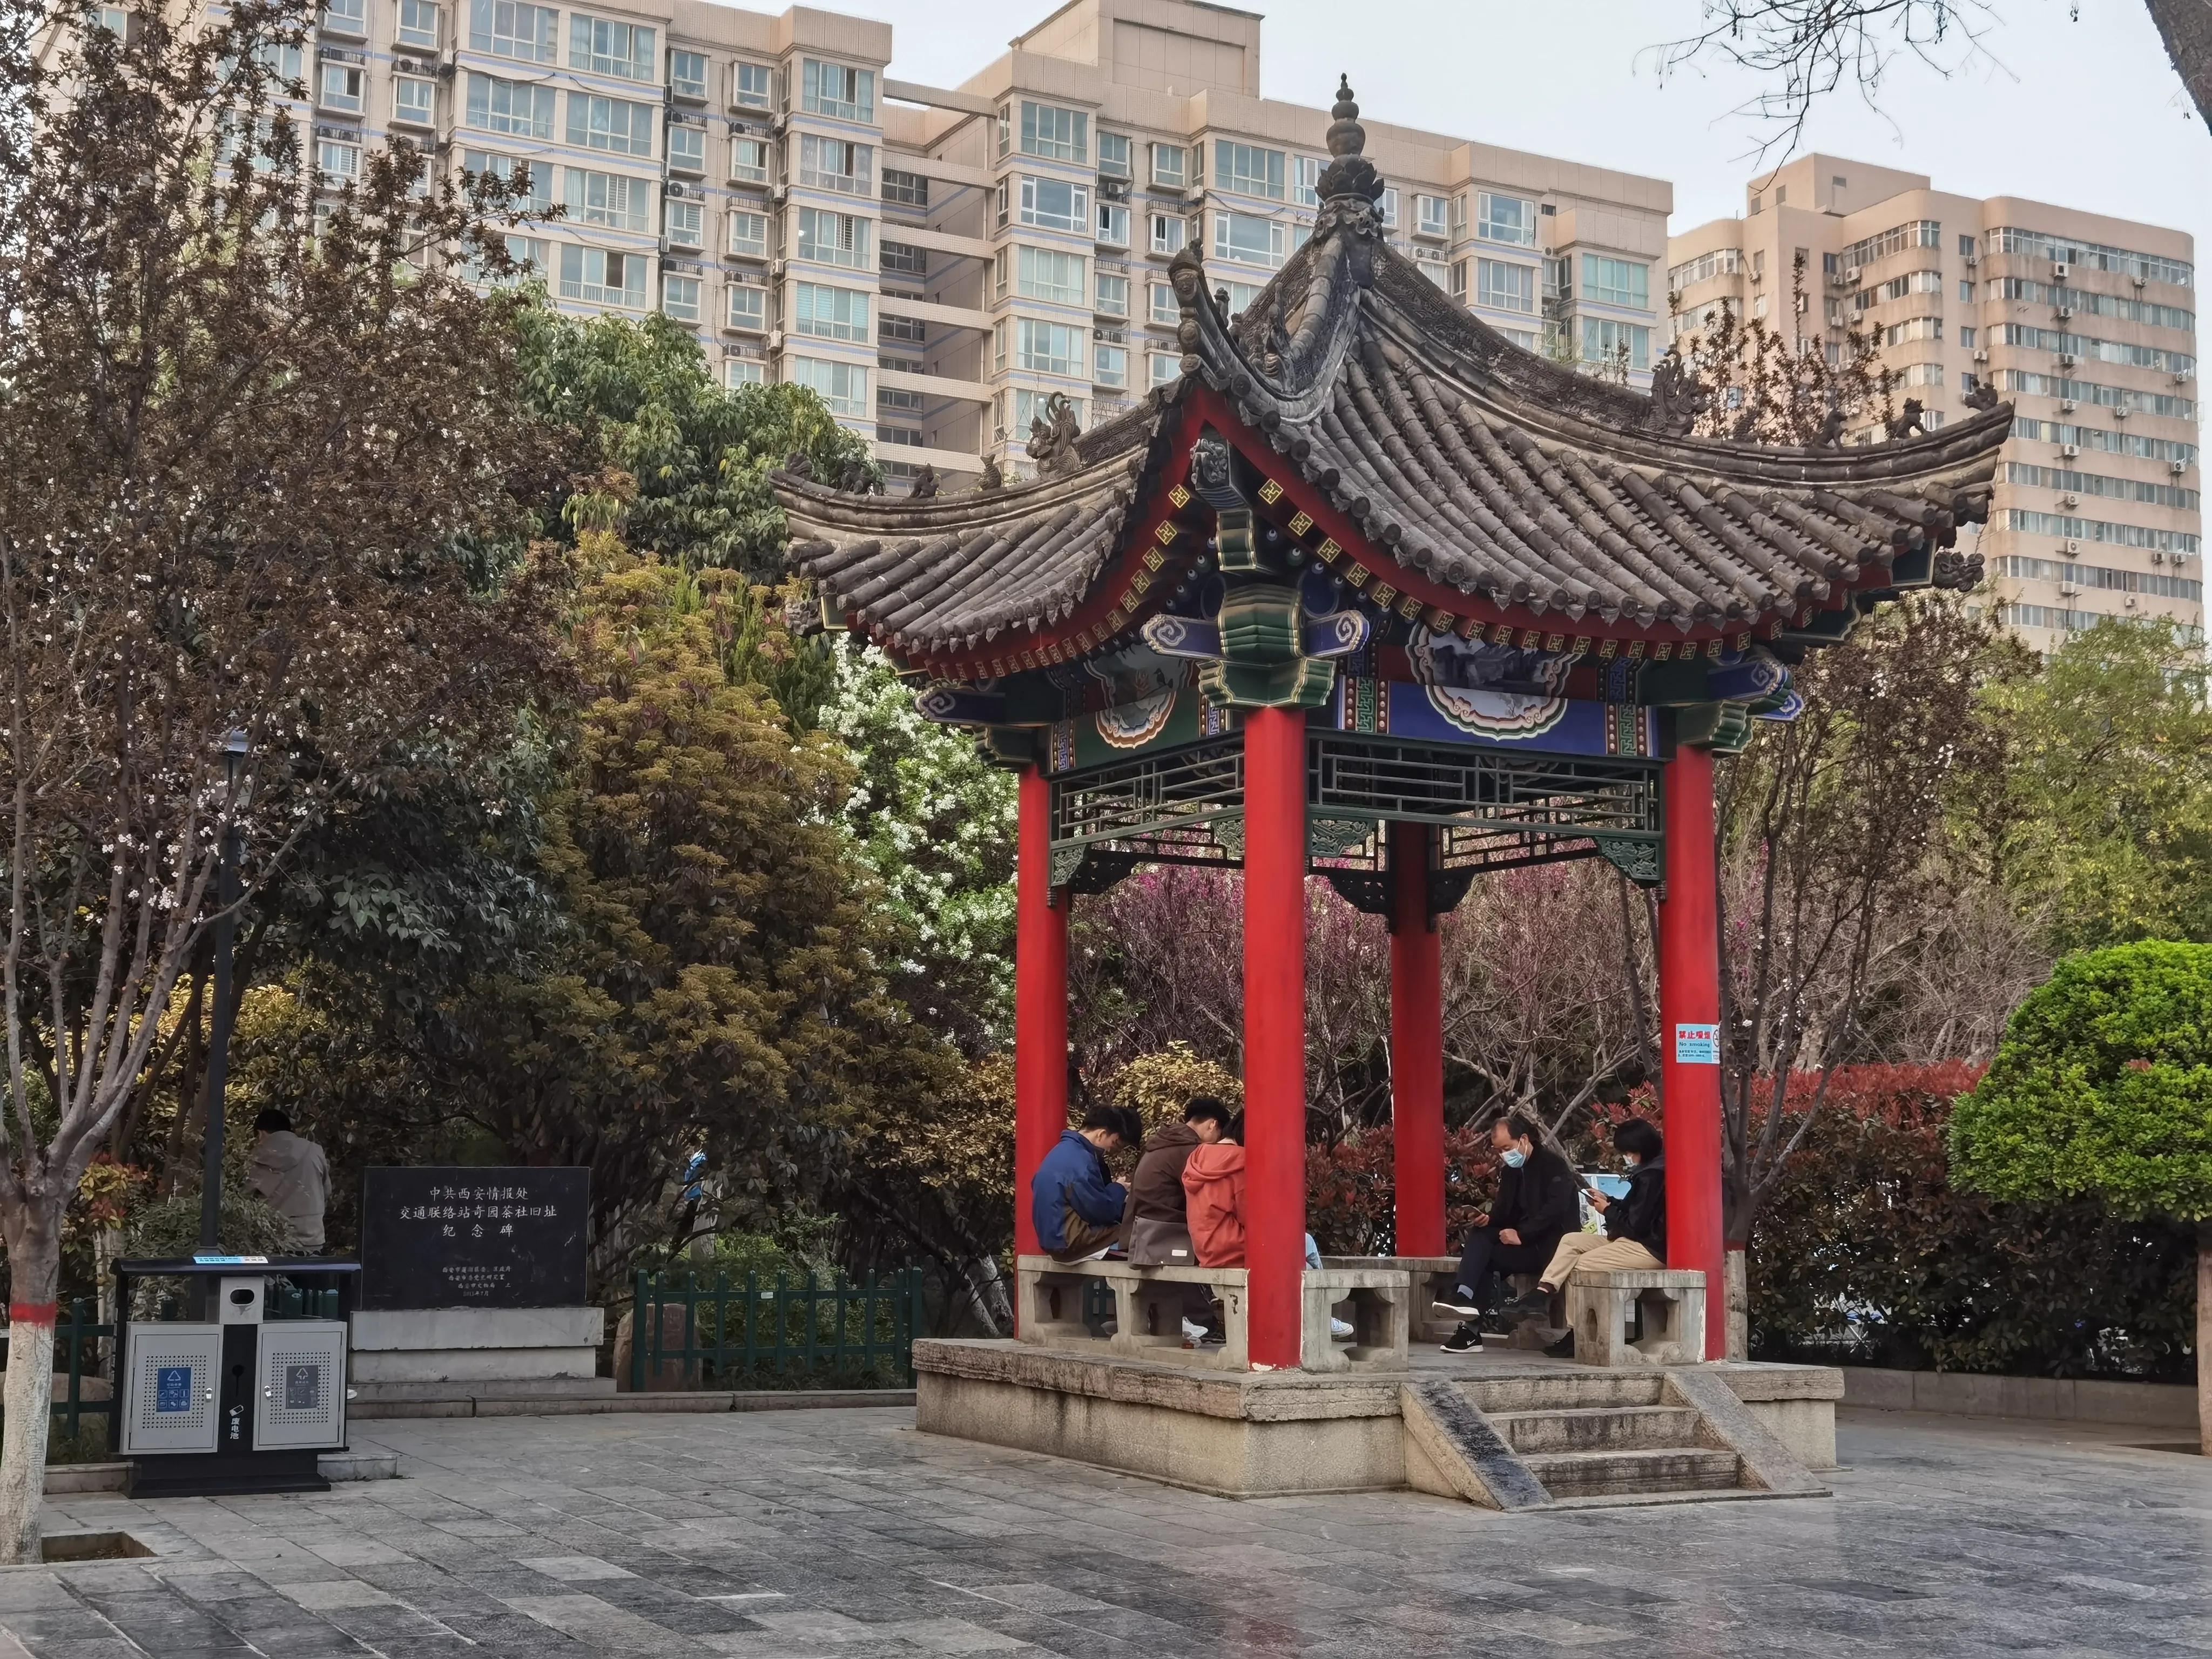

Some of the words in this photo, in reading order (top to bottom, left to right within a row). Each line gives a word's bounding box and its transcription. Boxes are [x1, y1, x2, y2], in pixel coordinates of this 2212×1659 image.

[430, 1186, 529, 1201] 中共西安情报处
[400, 1205, 557, 1219] 交通联络站奇园茶社旧址
